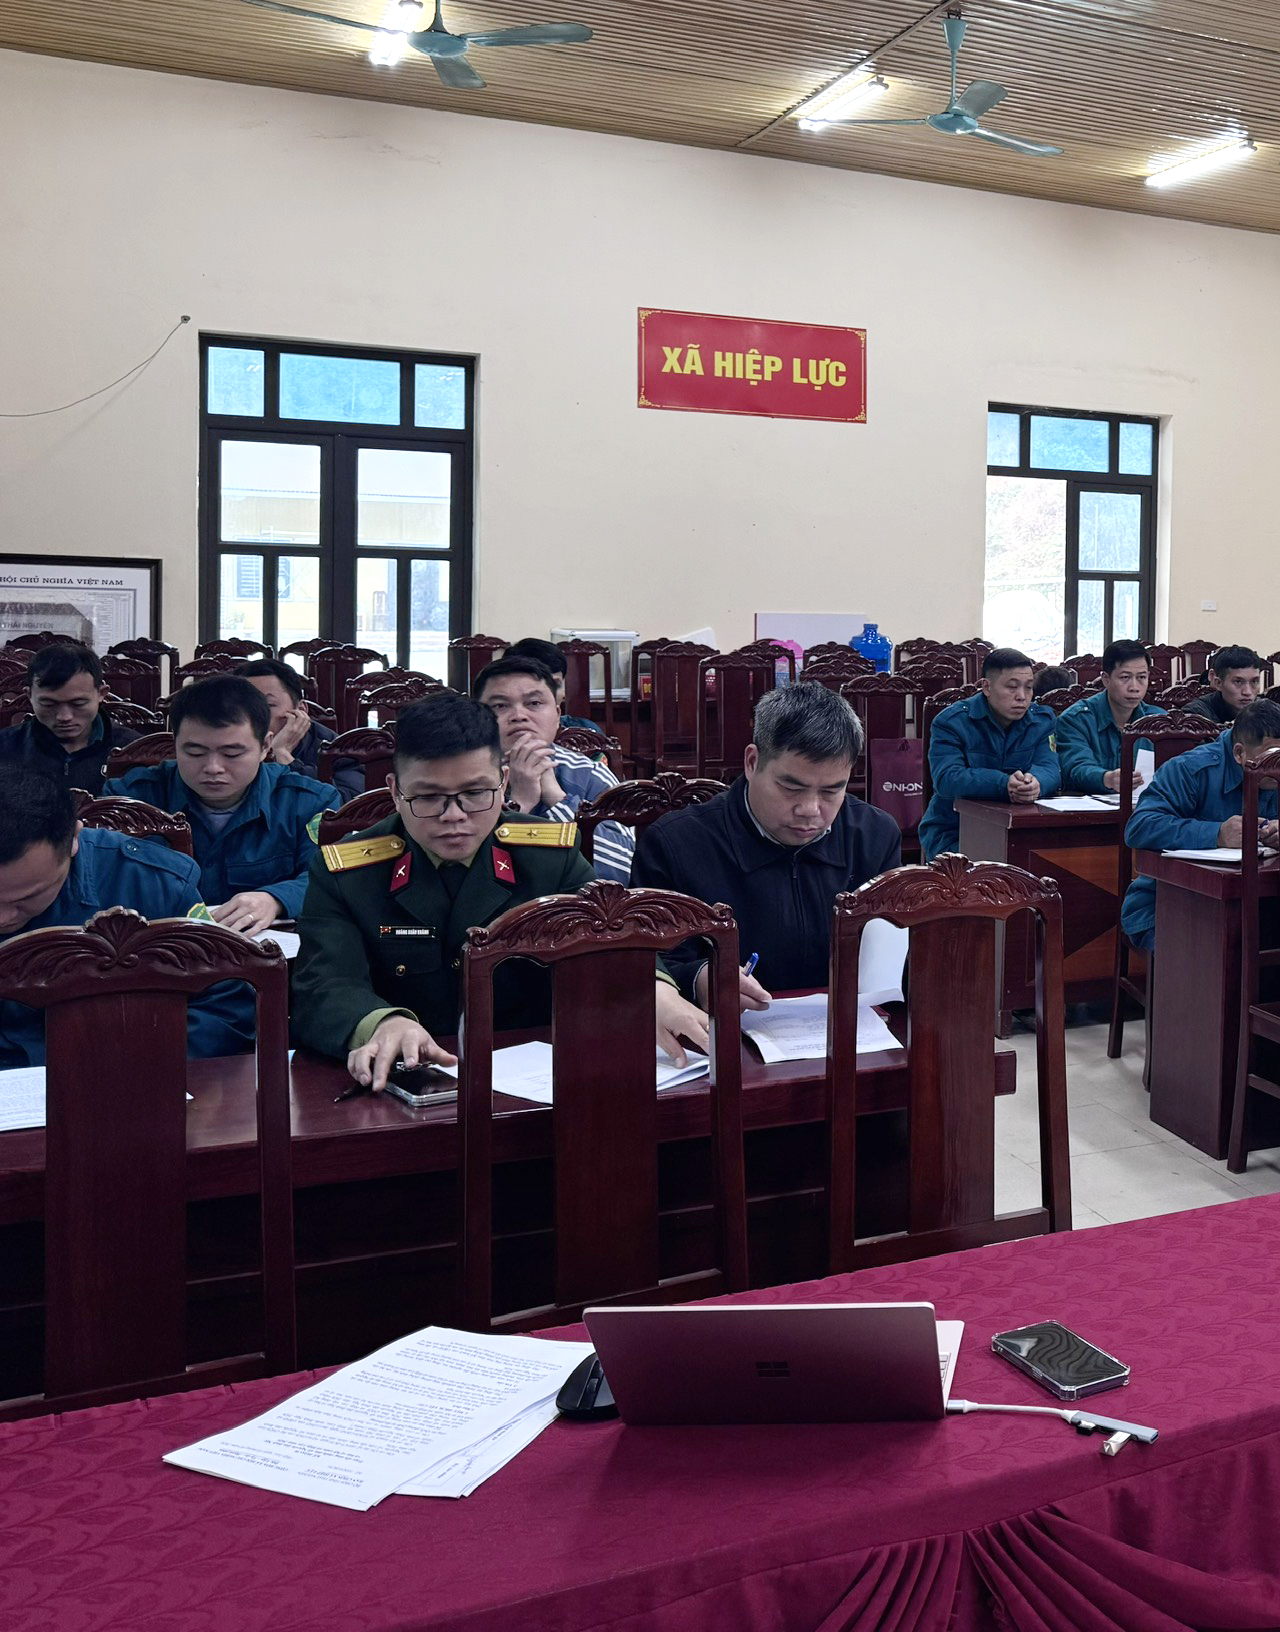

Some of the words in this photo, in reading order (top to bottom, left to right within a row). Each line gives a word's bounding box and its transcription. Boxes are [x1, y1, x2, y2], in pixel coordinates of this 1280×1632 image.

[662, 343, 704, 376] XÃ
[714, 349, 783, 385] HIỆP
[793, 357, 847, 391] LỰC
[19, 575, 40, 583] CHỦ
[42, 576, 74, 584] NGHĨA
[76, 577, 99, 586] VIỆT
